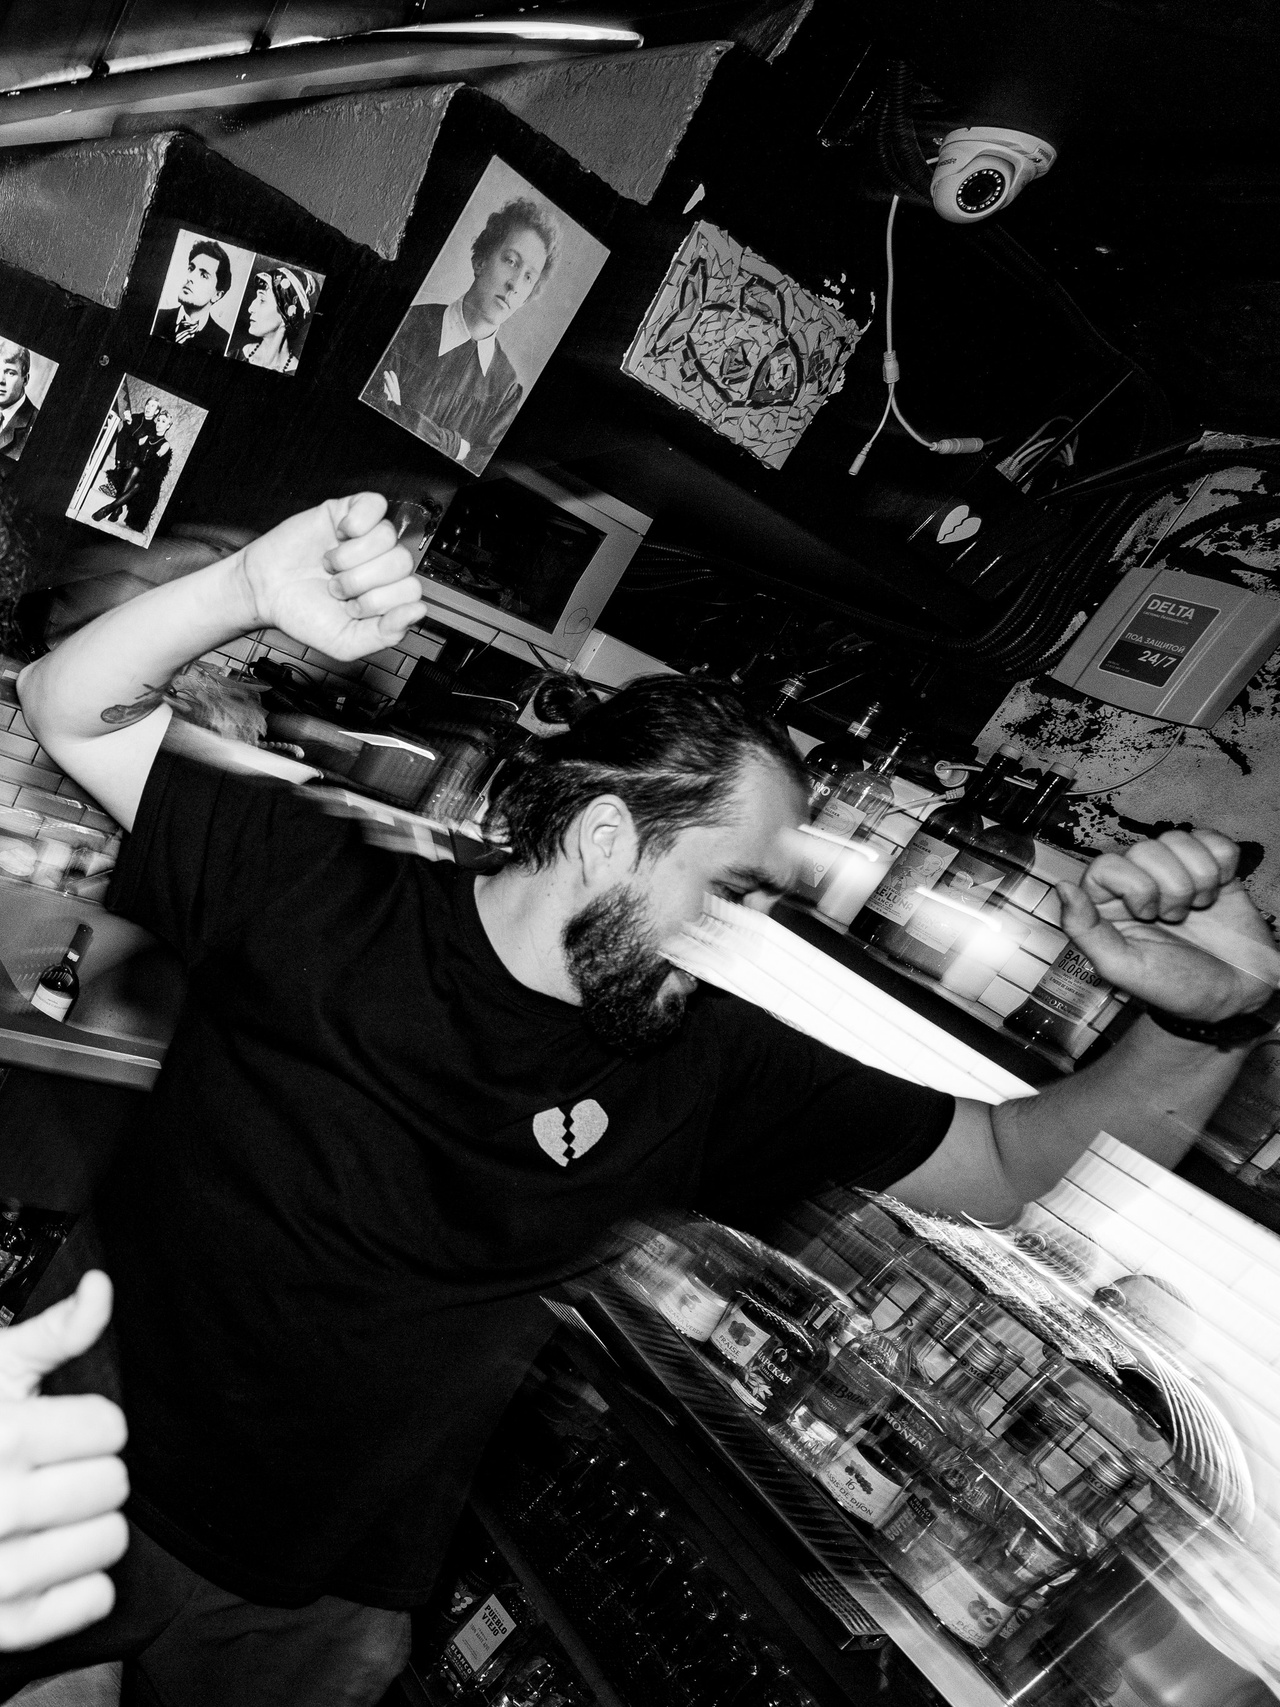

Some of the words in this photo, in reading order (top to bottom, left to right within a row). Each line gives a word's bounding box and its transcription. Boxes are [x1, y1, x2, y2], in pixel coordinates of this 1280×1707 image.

[1147, 599, 1196, 620] DELTA
[1125, 632, 1144, 643] ПОД
[1144, 637, 1186, 654] ЗАЩИТОЙ
[1138, 650, 1178, 668] 24/7
[1057, 959, 1102, 987] OLOROSO
[719, 1335, 742, 1357] FRAISE
[885, 1412, 926, 1450] MONIN
[845, 1478, 857, 1491] 16
[840, 1487, 849, 1499] DE
[850, 1497, 874, 1516] DIJON
[883, 1508, 917, 1541] COFFEE
[482, 1612, 500, 1637] VIEJO
[485, 1604, 508, 1635] PUEBLO
[450, 1644, 472, 1674] BLANCO
